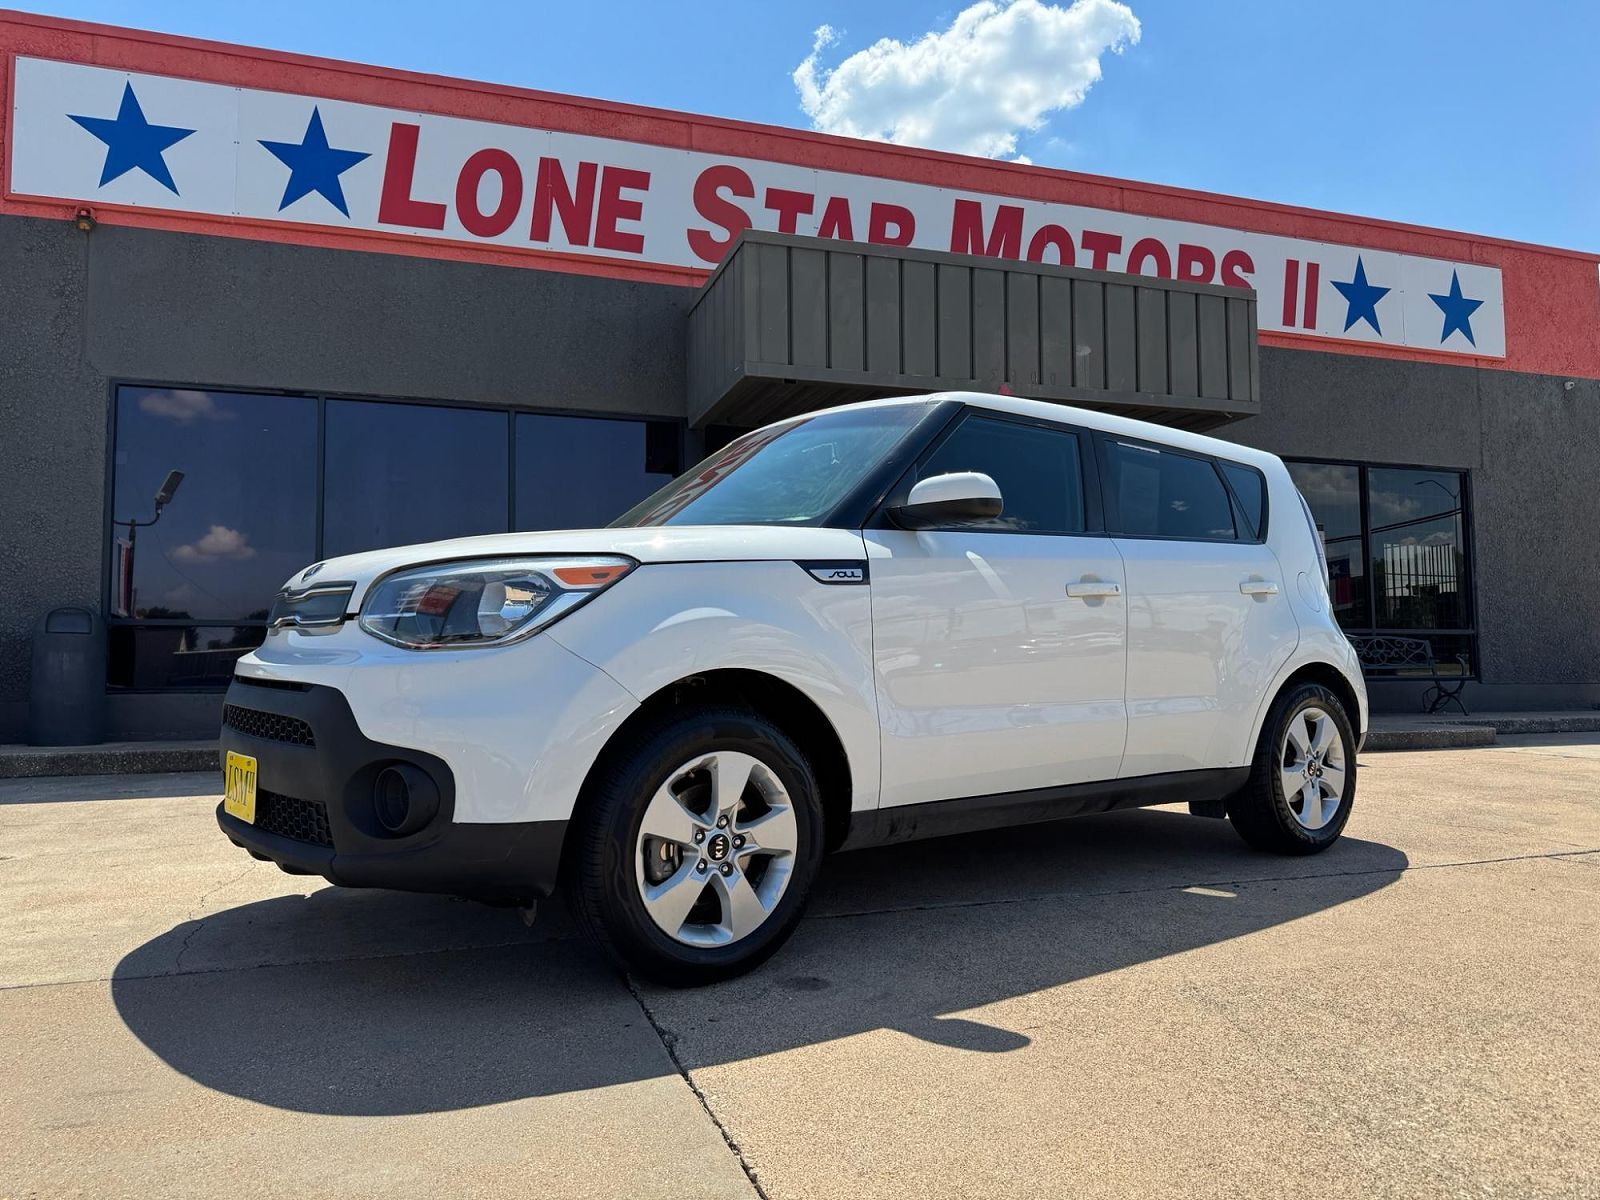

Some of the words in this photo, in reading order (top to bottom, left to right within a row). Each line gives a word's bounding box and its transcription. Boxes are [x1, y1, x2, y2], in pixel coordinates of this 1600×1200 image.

[378, 122, 651, 254] LONE
[1283, 260, 1319, 329] II
[715, 836, 723, 858] KIA
